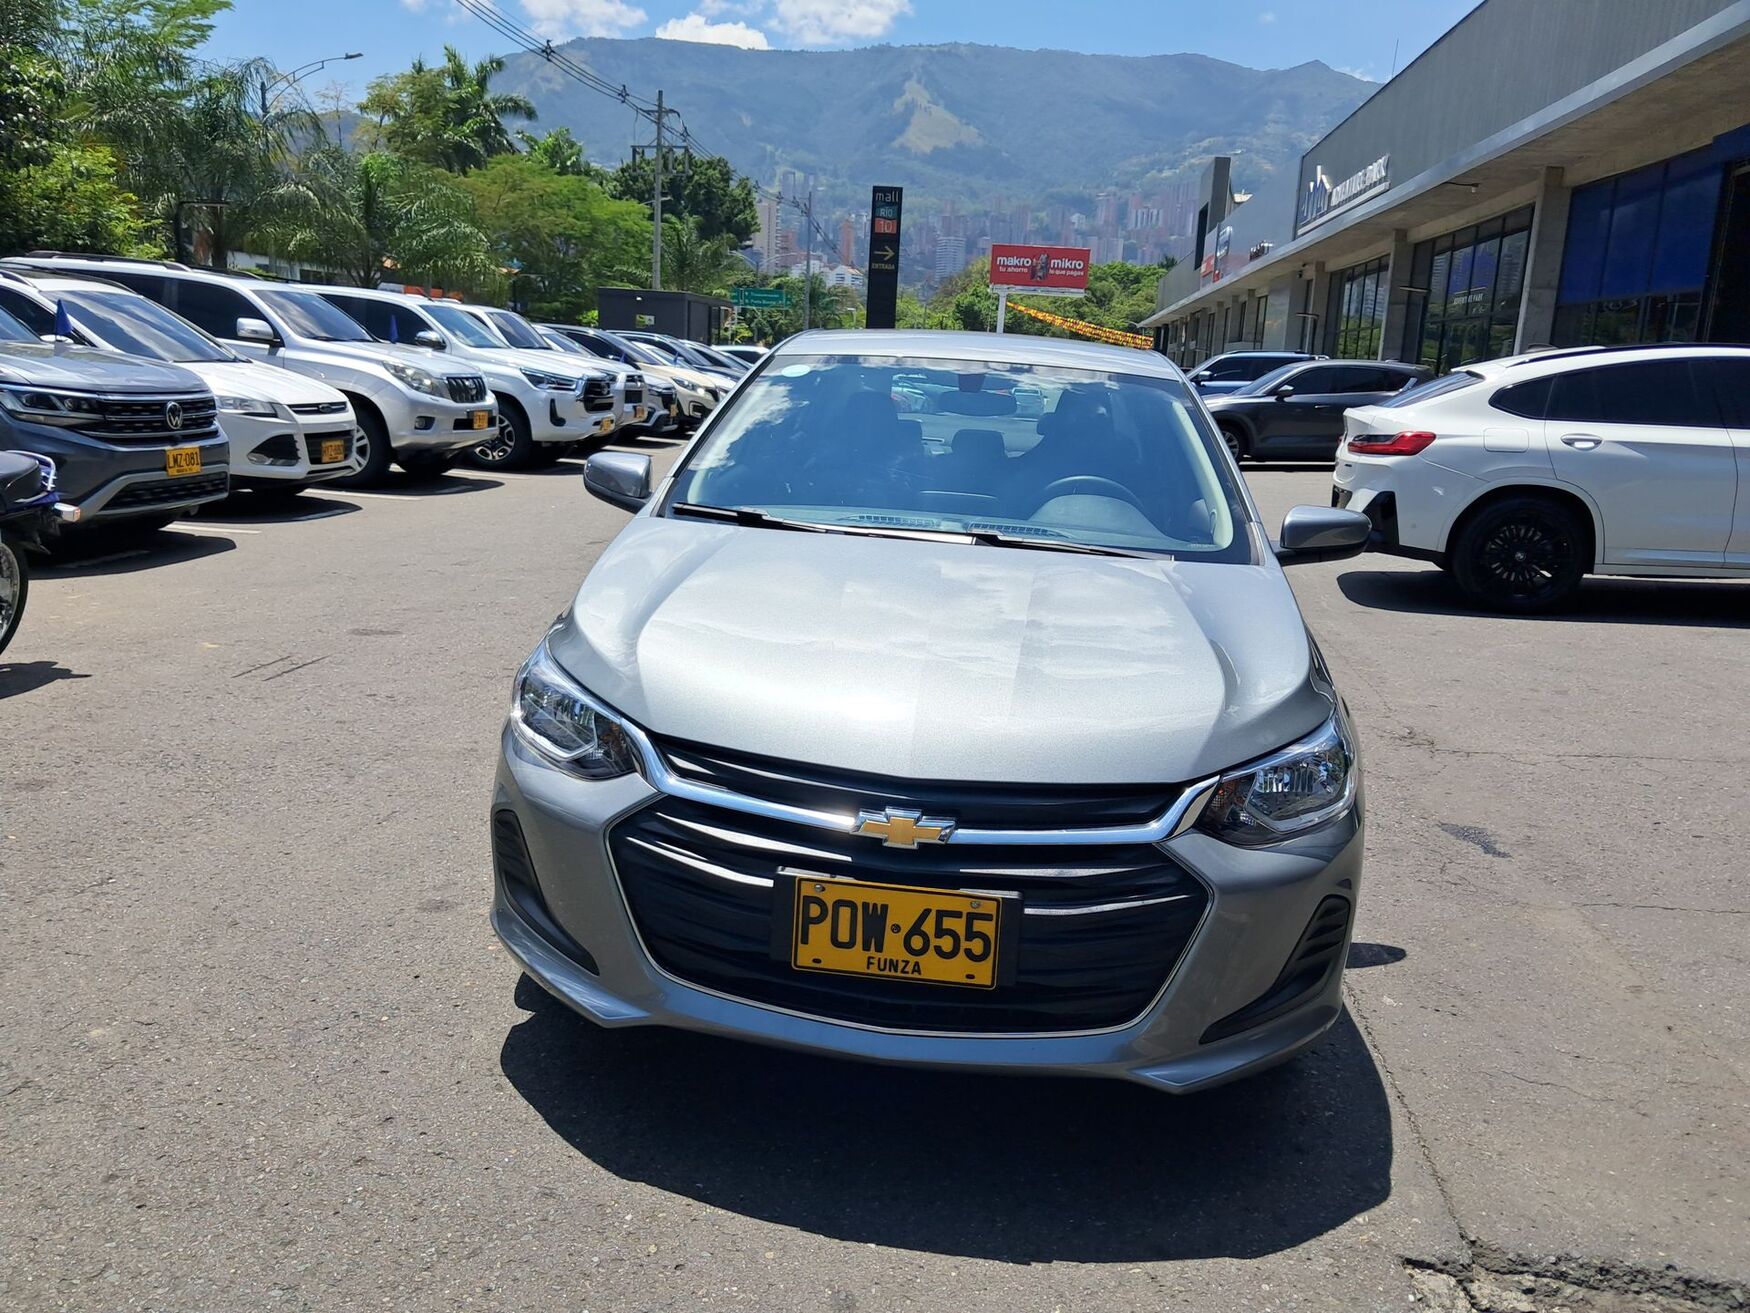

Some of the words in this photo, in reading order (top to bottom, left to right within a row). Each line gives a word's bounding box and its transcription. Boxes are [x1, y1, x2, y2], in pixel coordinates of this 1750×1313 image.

[875, 191, 899, 203] mall
[879, 220, 893, 233] 10
[996, 256, 1032, 267] makro
[1050, 258, 1084, 269] mikro
[866, 956, 922, 976] FUNZA
